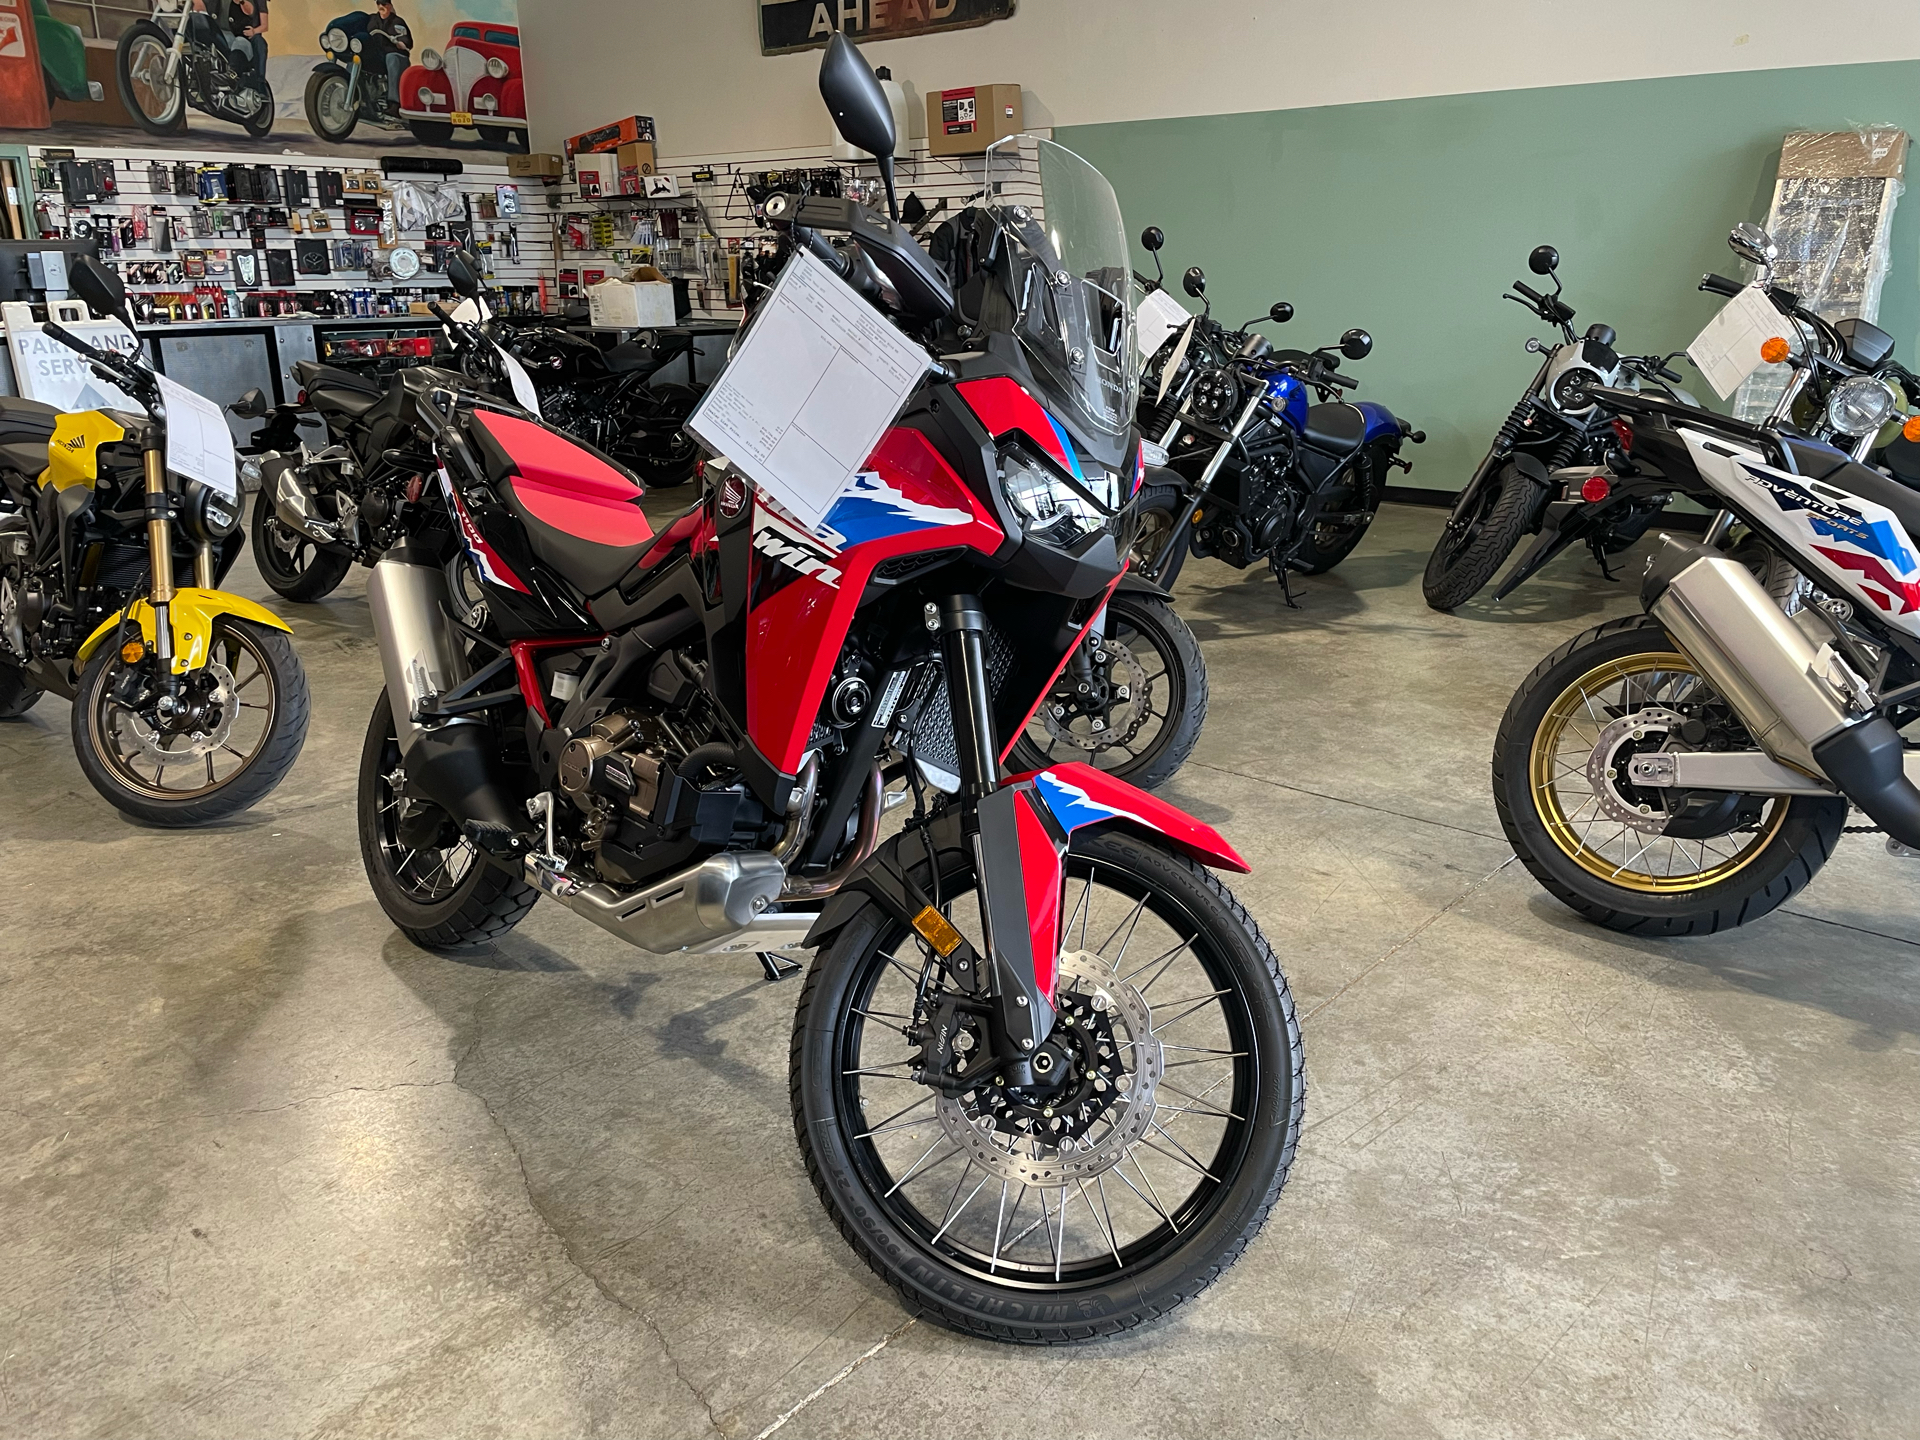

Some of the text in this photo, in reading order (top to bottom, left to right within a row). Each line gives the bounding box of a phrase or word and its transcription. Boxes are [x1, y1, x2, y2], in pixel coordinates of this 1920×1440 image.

[808, 0, 957, 38] AHEAD
[91, 334, 132, 350] AND
[38, 358, 88, 377] SERV
[1745, 475, 1864, 527] ADVENTURE
[1805, 511, 1869, 540] SPORTS
[910, 1264, 1069, 1322] MICHELIN
